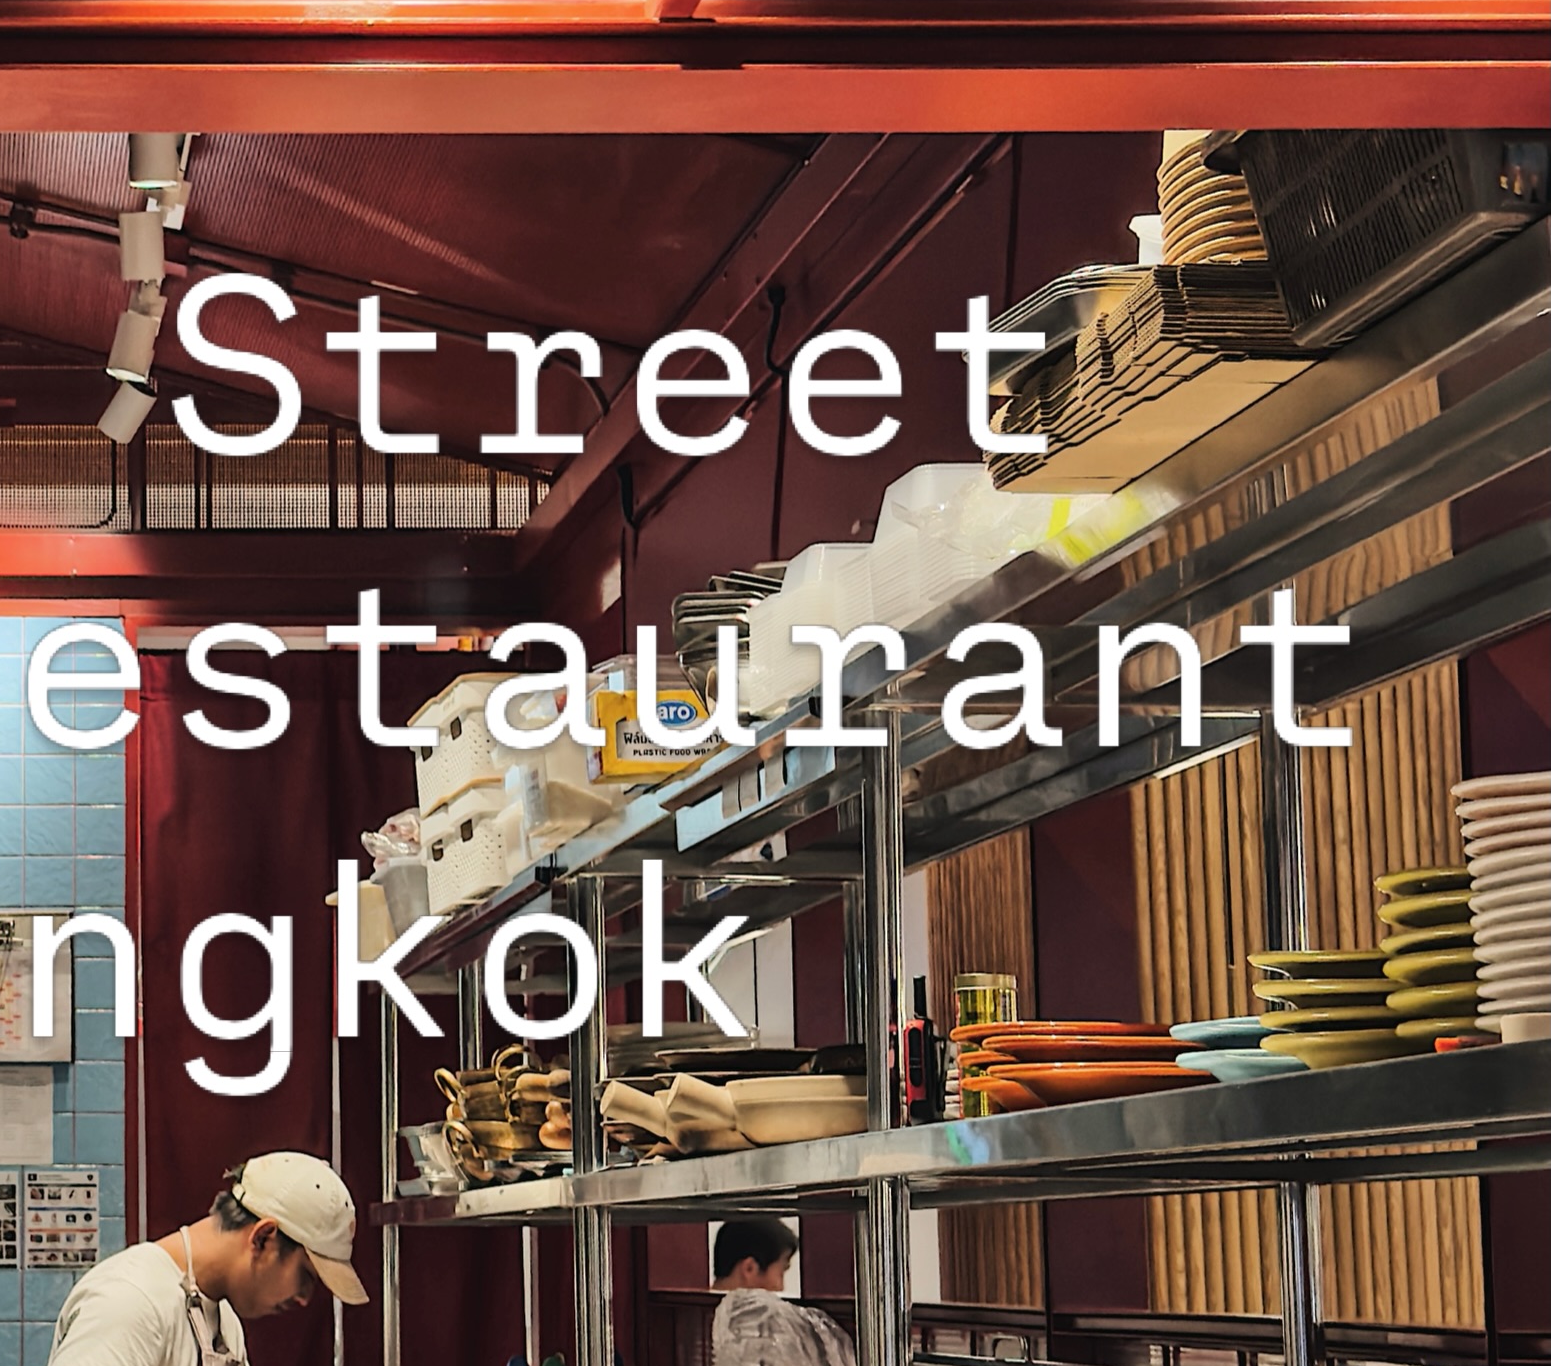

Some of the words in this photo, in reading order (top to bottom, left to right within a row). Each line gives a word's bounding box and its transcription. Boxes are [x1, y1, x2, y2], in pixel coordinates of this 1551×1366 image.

[657, 705, 691, 721] aro
[633, 748, 667, 756] PLASTIC
[669, 748, 691, 756] FOOD
